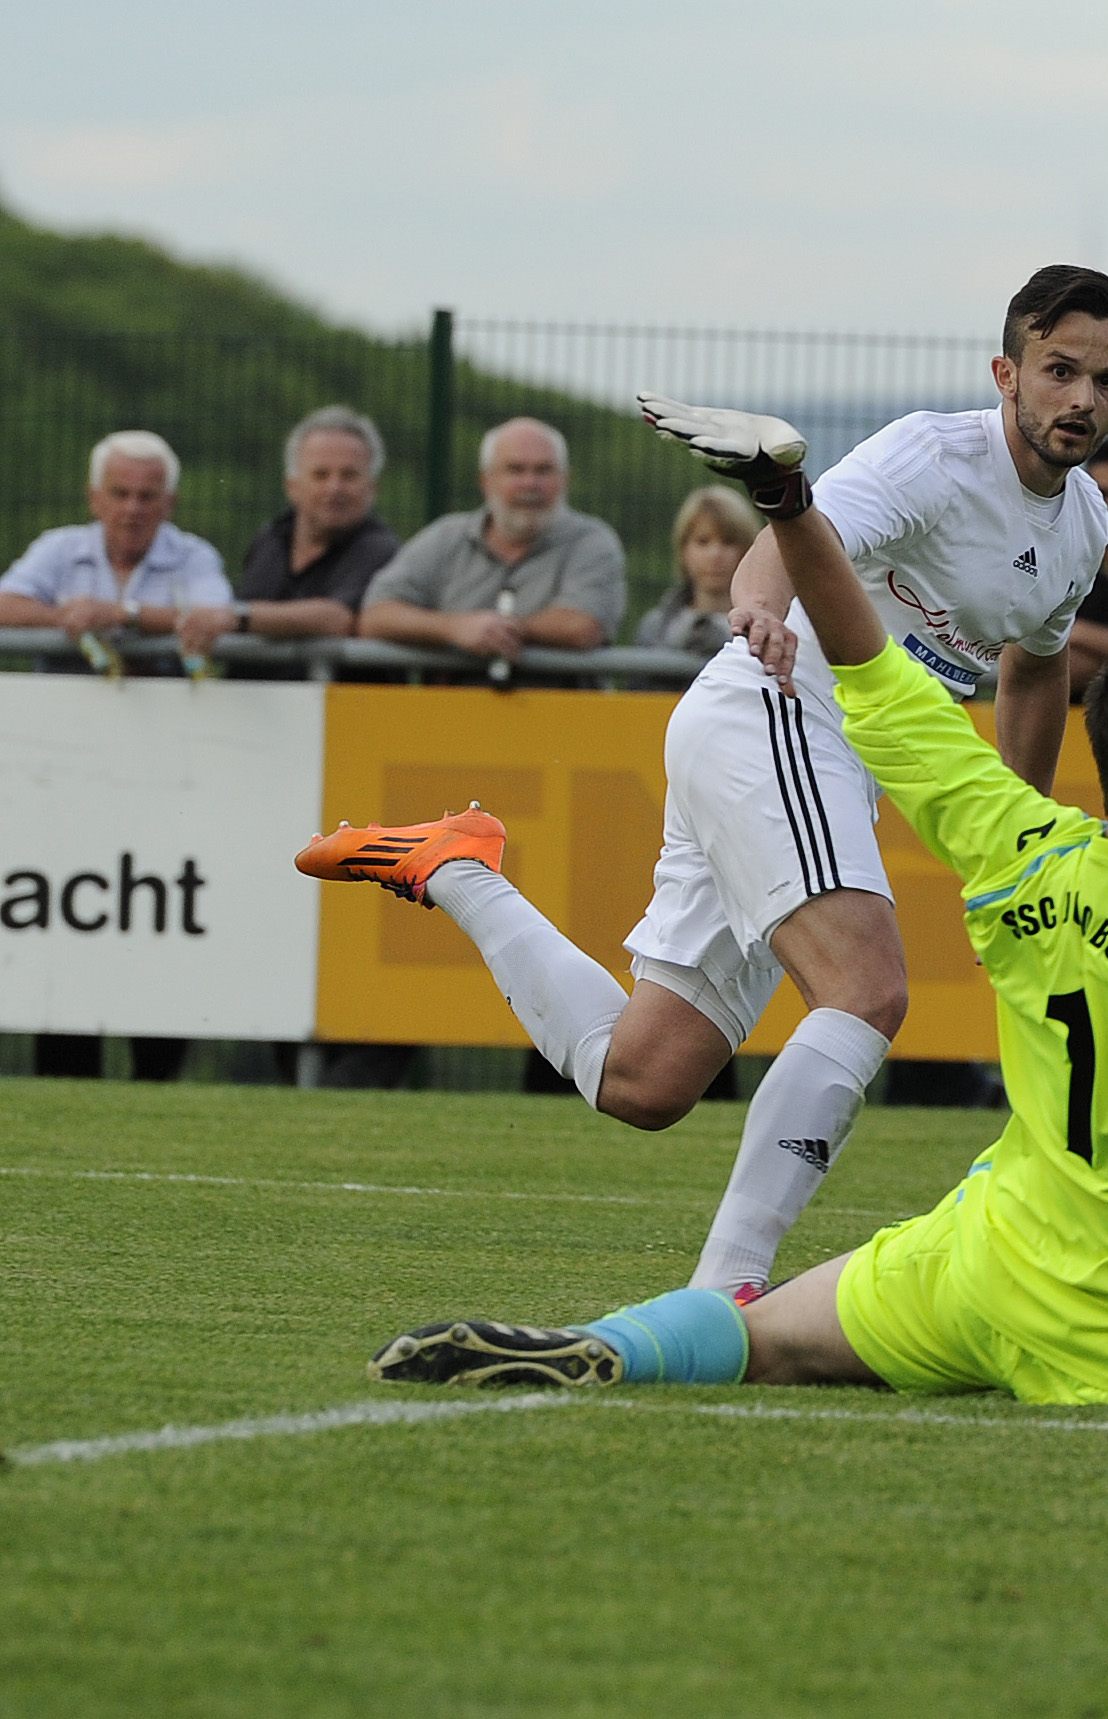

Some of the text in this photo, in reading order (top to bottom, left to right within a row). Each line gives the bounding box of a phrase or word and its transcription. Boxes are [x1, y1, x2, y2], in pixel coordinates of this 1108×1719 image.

[0, 853, 205, 935] acht
[1001, 896, 1057, 939] SSC
[1046, 988, 1096, 1166] 1
